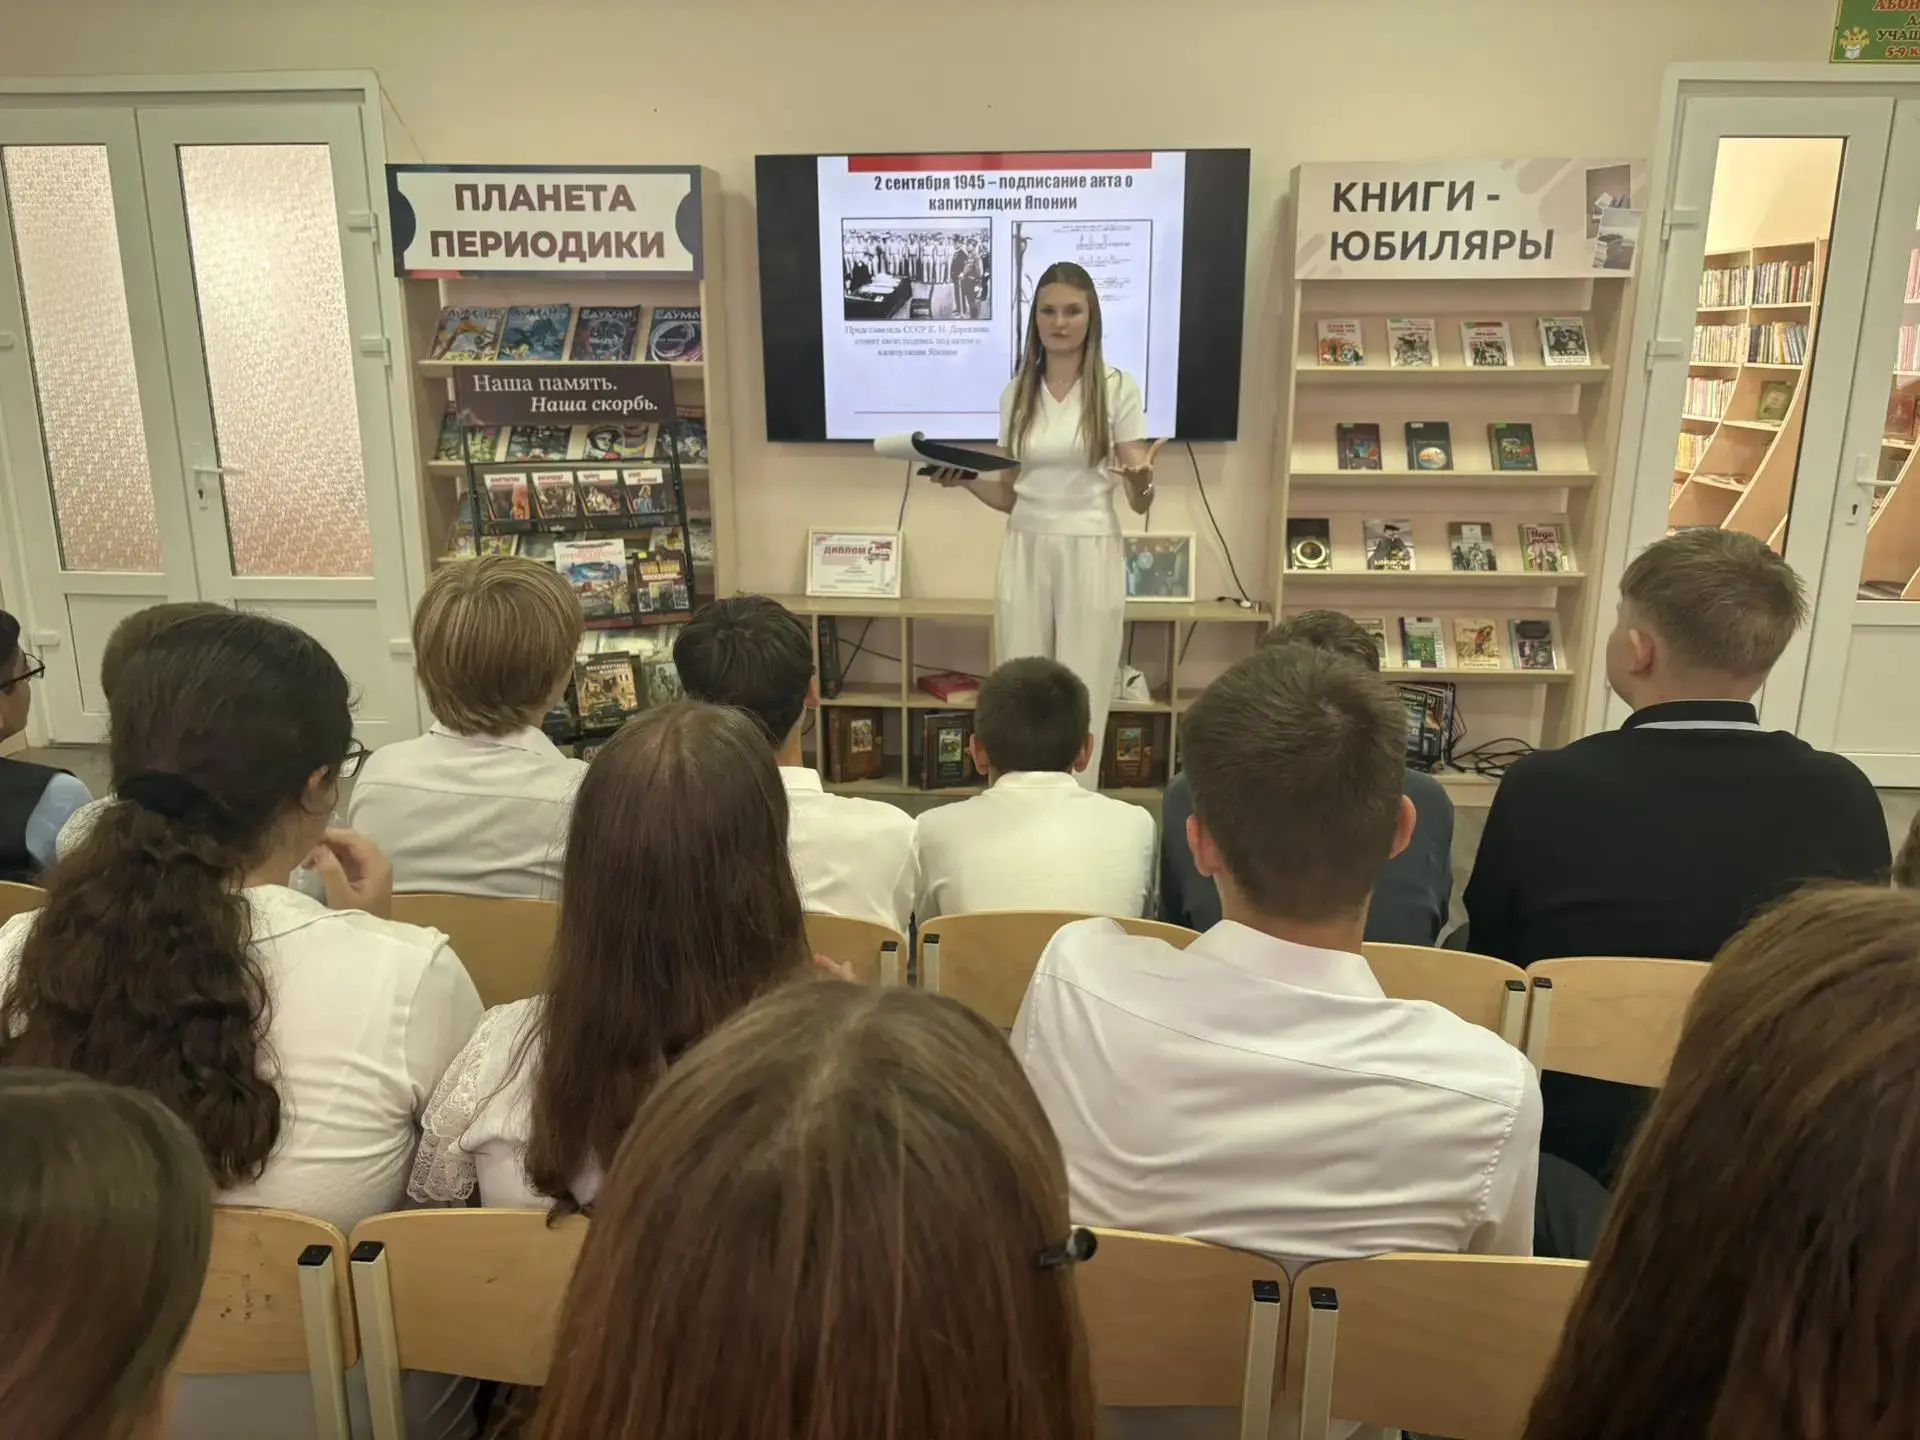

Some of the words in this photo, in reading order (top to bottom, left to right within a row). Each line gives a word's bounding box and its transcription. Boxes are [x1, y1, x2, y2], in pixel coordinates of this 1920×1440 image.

[874, 176, 882, 190] 2
[885, 175, 950, 191] сентября
[953, 175, 985, 190] 1945
[999, 175, 1087, 191] подписание
[1090, 175, 1121, 188] акта
[1125, 175, 1133, 188] о
[454, 184, 636, 212] ПЛАНЕТА
[929, 197, 1021, 212] капитуляции
[1025, 195, 1077, 210] Японии
[1332, 180, 1475, 213] КНИГИ
[430, 230, 665, 263] ПЕРИОДИКИ
[1329, 229, 1554, 262] ЮБИЛЯРЫ
[472, 374, 533, 391] Наша
[538, 377, 617, 391] память.
[530, 396, 588, 412] Наша
[592, 395, 658, 415] скорбь.
